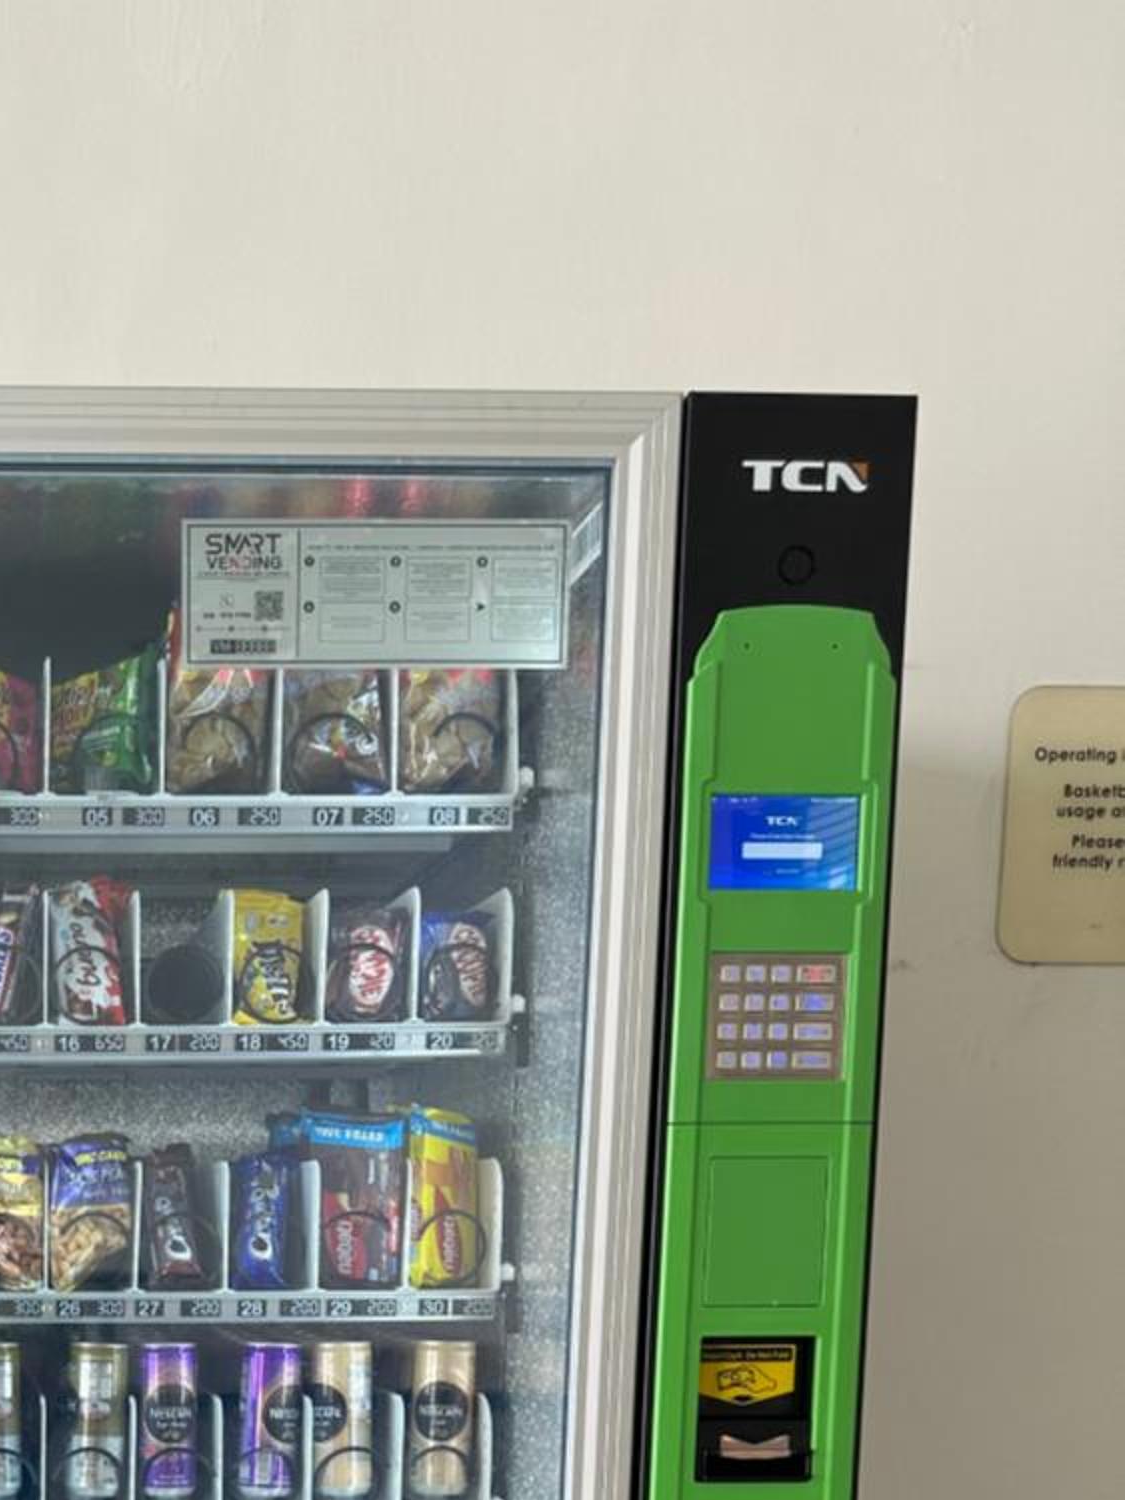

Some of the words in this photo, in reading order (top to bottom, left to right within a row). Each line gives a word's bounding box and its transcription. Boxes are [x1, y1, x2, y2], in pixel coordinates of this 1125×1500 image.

[741, 459, 871, 493] TCN
[205, 532, 283, 555] SMART
[207, 556, 283, 570] VENDING
[1035, 747, 1117, 765] Operating
[85, 808, 107, 824] 05
[192, 808, 215, 824] 06
[316, 808, 339, 824] 07
[433, 808, 457, 824] 08
[1057, 804, 1106, 822] usage
[1053, 854, 1113, 871] friendly
[60, 1036, 79, 1049] 16
[150, 1035, 170, 1049] 17
[239, 1035, 260, 1049] 18
[329, 1035, 349, 1049] 19
[432, 1035, 453, 1049] 20
[139, 1301, 159, 1315] 27
[241, 1301, 261, 1315] 28
[331, 1301, 351, 1315] 29
